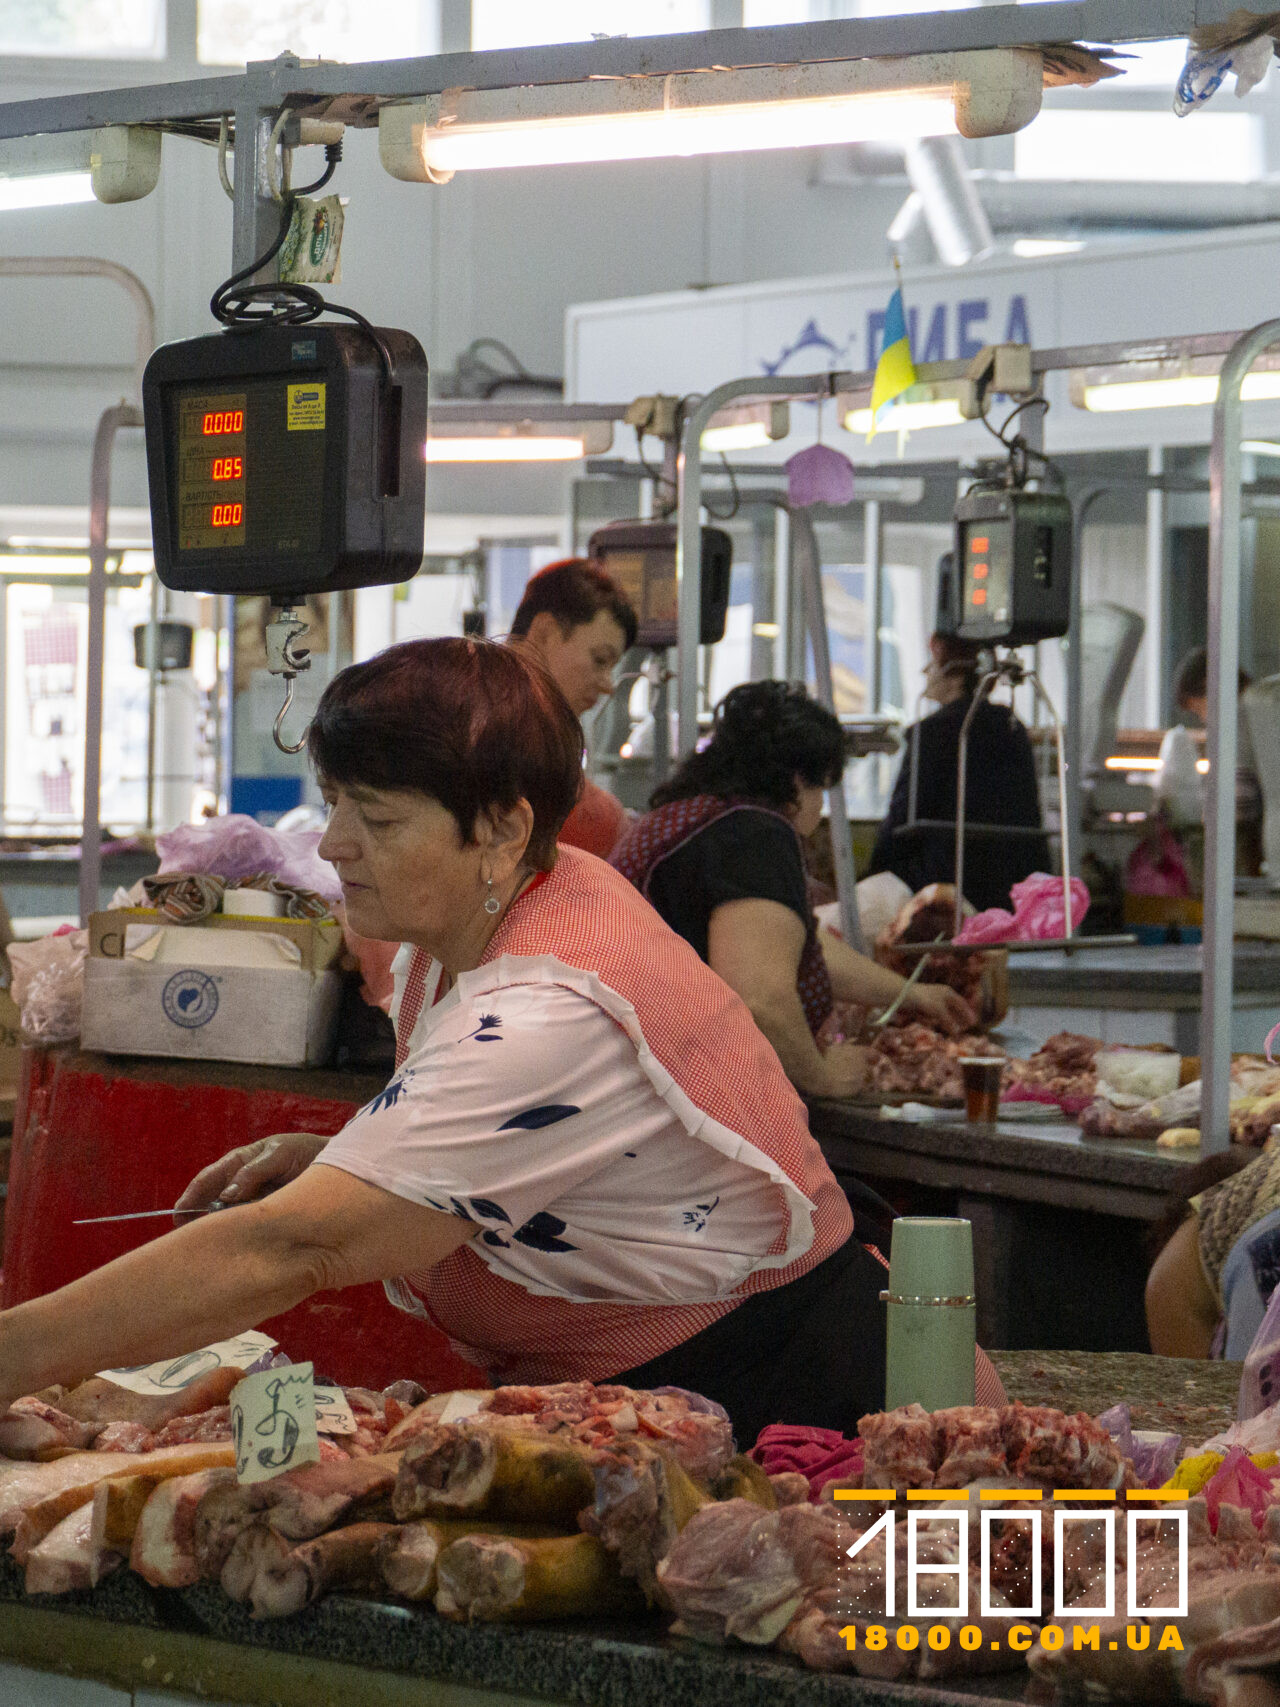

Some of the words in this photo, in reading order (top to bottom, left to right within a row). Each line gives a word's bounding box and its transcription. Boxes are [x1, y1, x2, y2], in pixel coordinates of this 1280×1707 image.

[203, 411, 243, 435] 0.000
[212, 457, 242, 480] 0.85
[212, 503, 242, 527] 0.00
